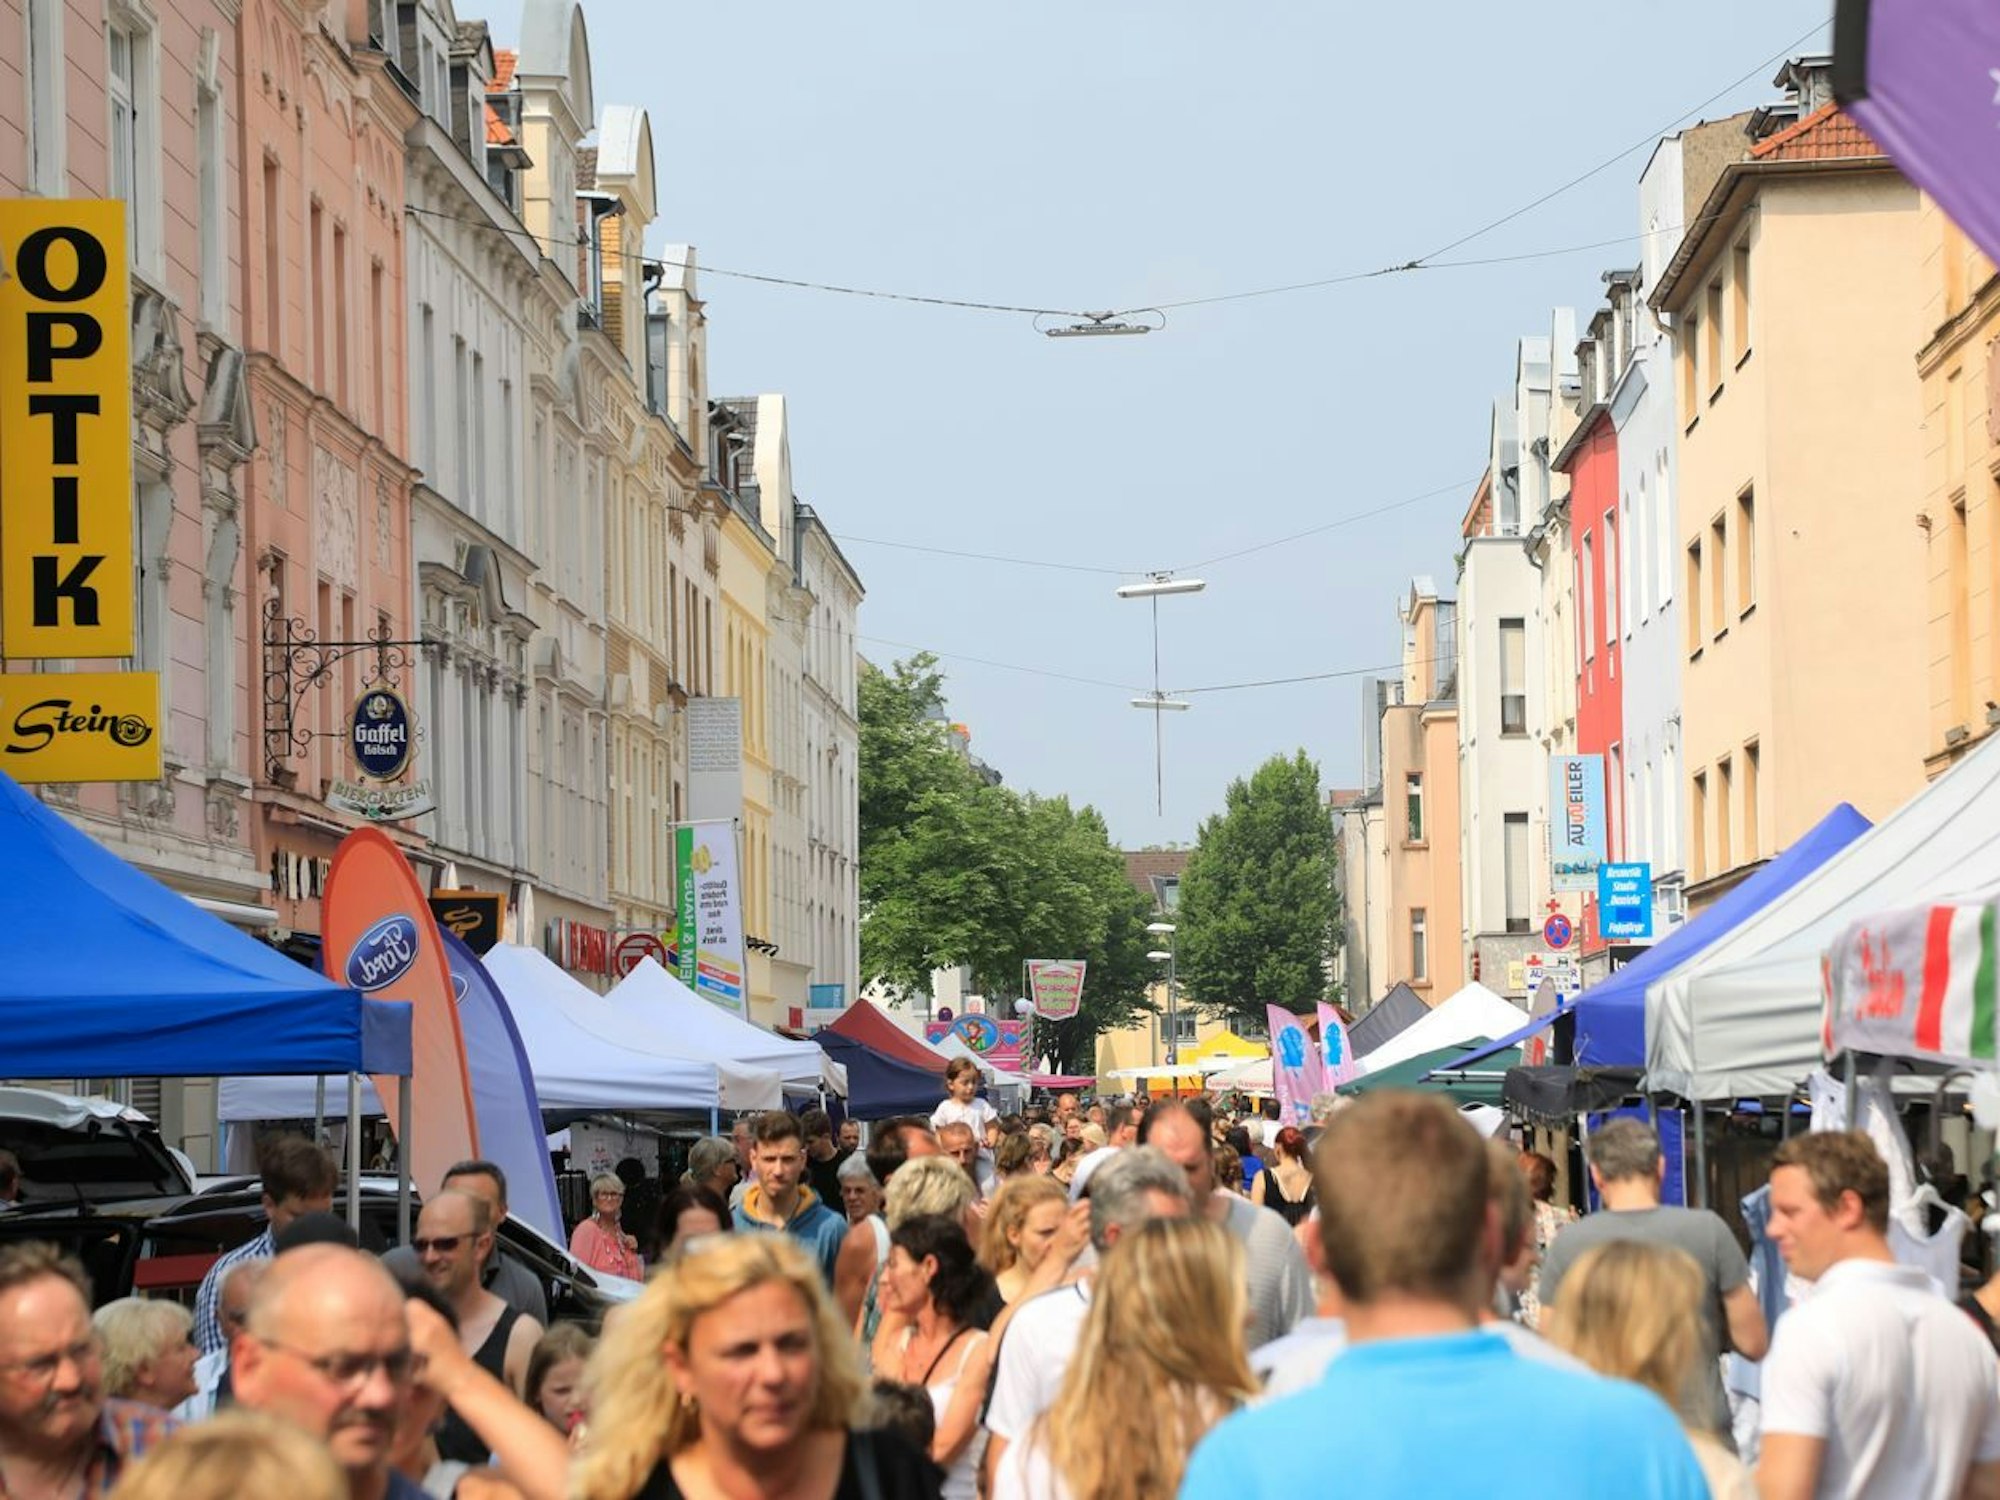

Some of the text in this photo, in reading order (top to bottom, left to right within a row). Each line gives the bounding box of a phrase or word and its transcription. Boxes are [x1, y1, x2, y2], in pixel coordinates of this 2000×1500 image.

[15, 226, 109, 627] OPTIK
[354, 722, 407, 744] Gaffel
[332, 781, 428, 806] BIERGARTEN
